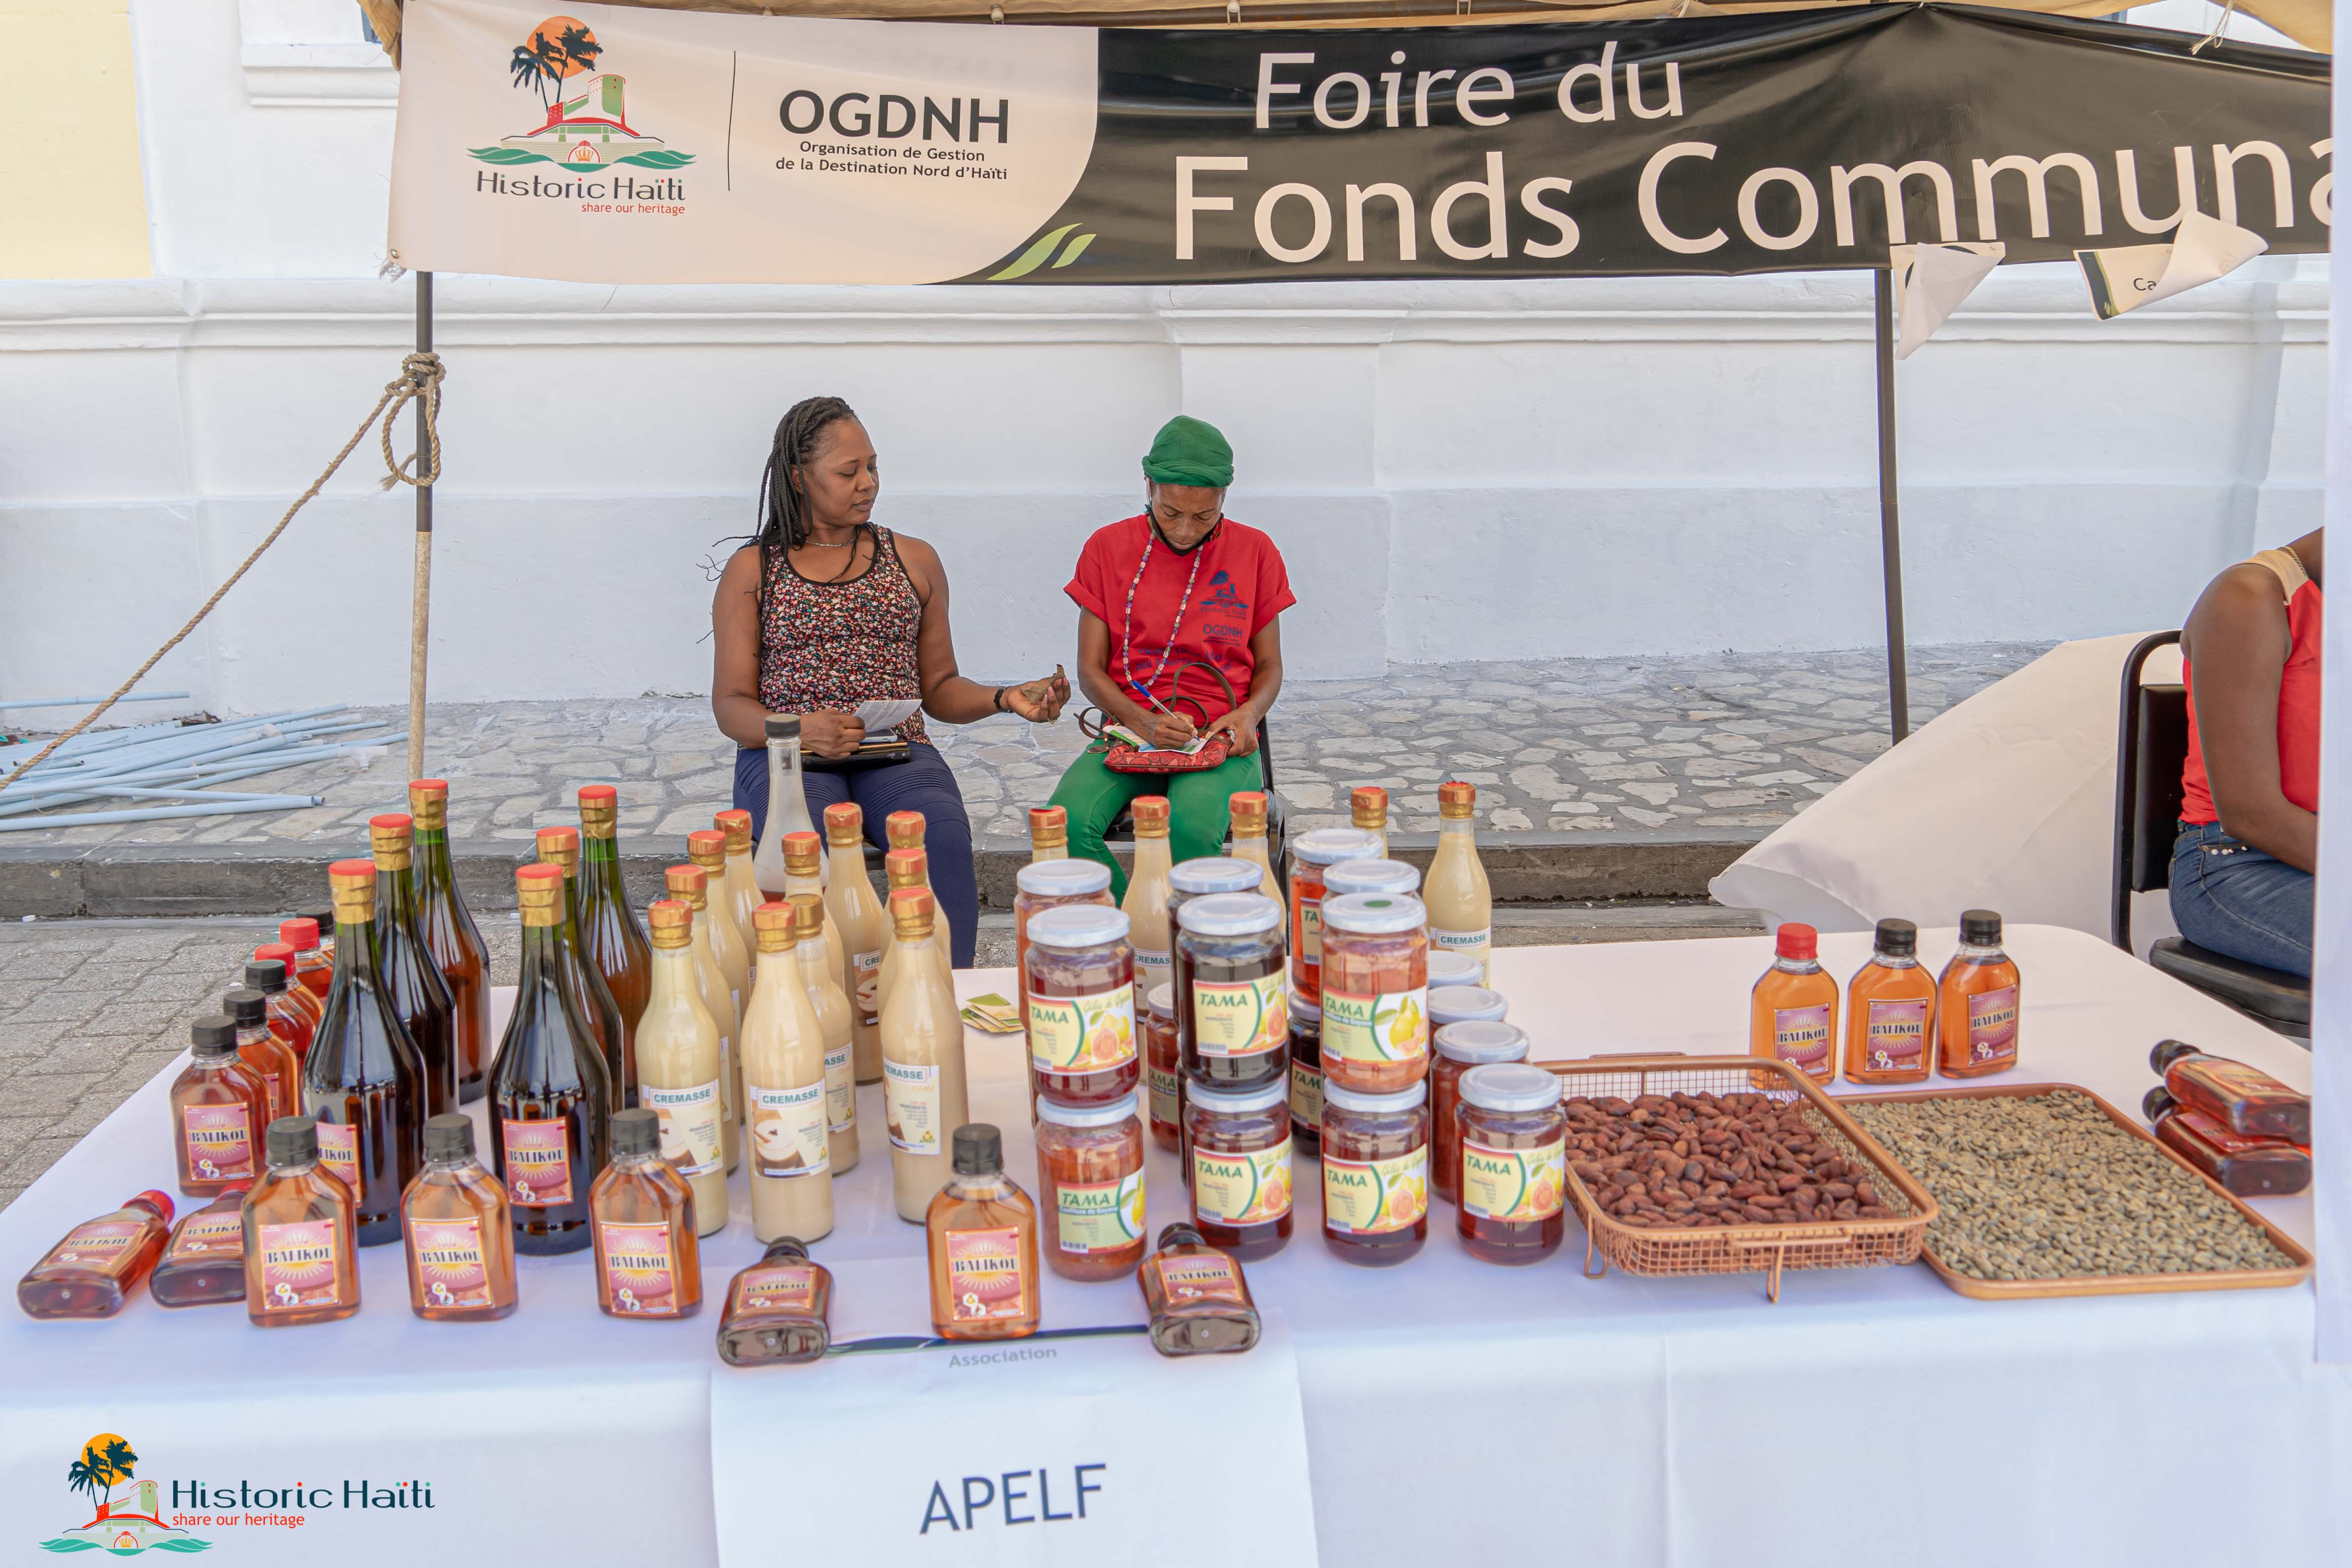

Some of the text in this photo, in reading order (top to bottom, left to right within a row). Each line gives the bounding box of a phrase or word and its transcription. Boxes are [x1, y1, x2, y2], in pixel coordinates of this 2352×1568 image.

[1256, 40, 1684, 129] Foire du
[780, 89, 1009, 144] OGDNH
[800, 141, 985, 161] Organisation de Gestion
[776, 157, 795, 169] de
[801, 158, 814, 170] la
[820, 159, 907, 175] Destination
[913, 164, 950, 177] Nord
[477, 170, 686, 201] Historic Haïti
[582, 202, 685, 216] share our heritage
[1176, 151, 1580, 263] Fonds
[2133, 277, 2160, 291] Ca
[1203, 624, 1243, 639] OGDNH
[1304, 910, 1319, 923] TA
[1440, 933, 1486, 944] CREMASSE
[1134, 954, 1170, 965] CREMAS
[1201, 993, 1248, 1007] TAMA
[1325, 995, 1364, 1018] TAMA
[1031, 1006, 1069, 1024] TAMA
[1779, 1028, 1827, 1043] BALIKOU
[1872, 1023, 1922, 1035] BALIKOU
[1294, 1069, 1321, 1090] TAM
[654, 1088, 711, 1103] CREMASSE
[762, 1088, 819, 1104] CREMASSE
[192, 1129, 247, 1142] BALIKOU
[510, 1149, 565, 1163] BALIKOU
[1199, 1161, 1243, 1178] TAMA
[1466, 1154, 1511, 1176] TAMA
[1328, 1169, 1367, 1187] TAMA
[1063, 1192, 1110, 1207] TAMA
[268, 1247, 332, 1264] BALIKOU
[422, 1251, 480, 1263] BALIKOU
[610, 1255, 668, 1269] BALIKOU
[955, 1258, 1018, 1273] BALIKOU
[948, 1347, 1058, 1369] Association
[919, 1463, 1106, 1535] APELF
